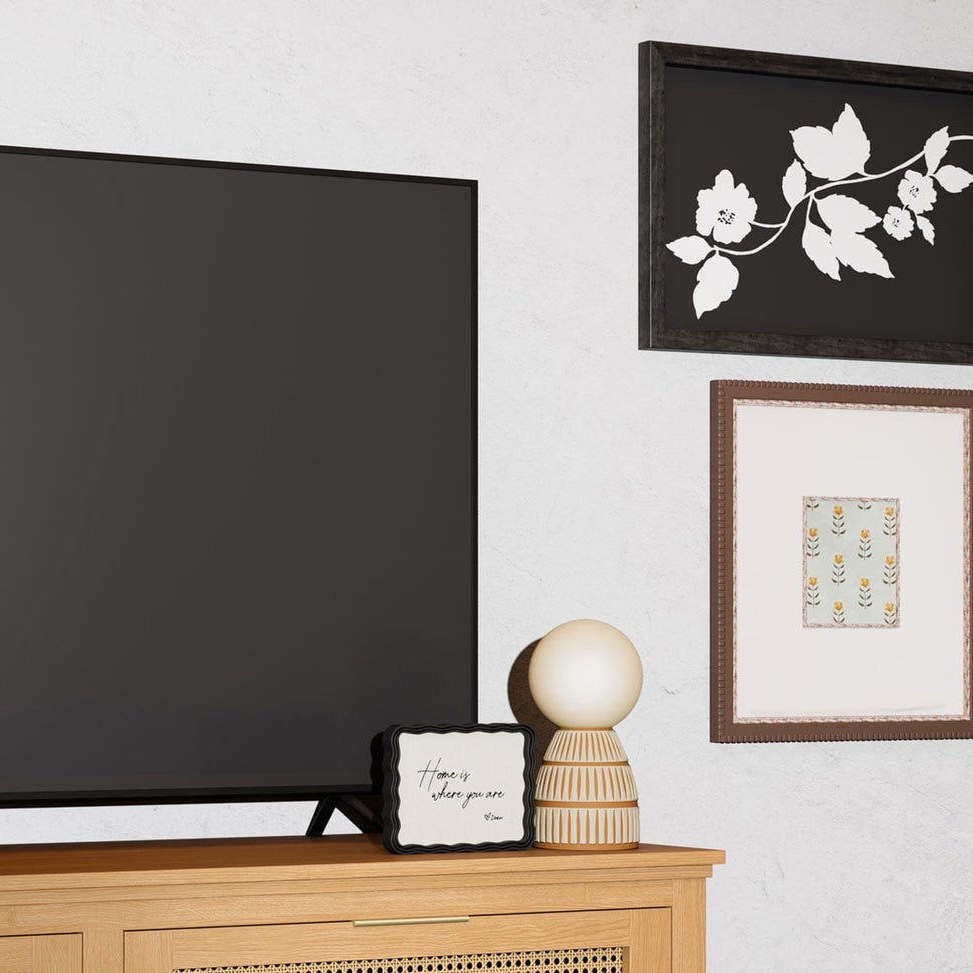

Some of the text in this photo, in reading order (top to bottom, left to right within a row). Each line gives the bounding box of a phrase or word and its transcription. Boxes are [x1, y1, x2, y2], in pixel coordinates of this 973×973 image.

[417, 757, 470, 792] Home is
[431, 781, 505, 809] where you are
